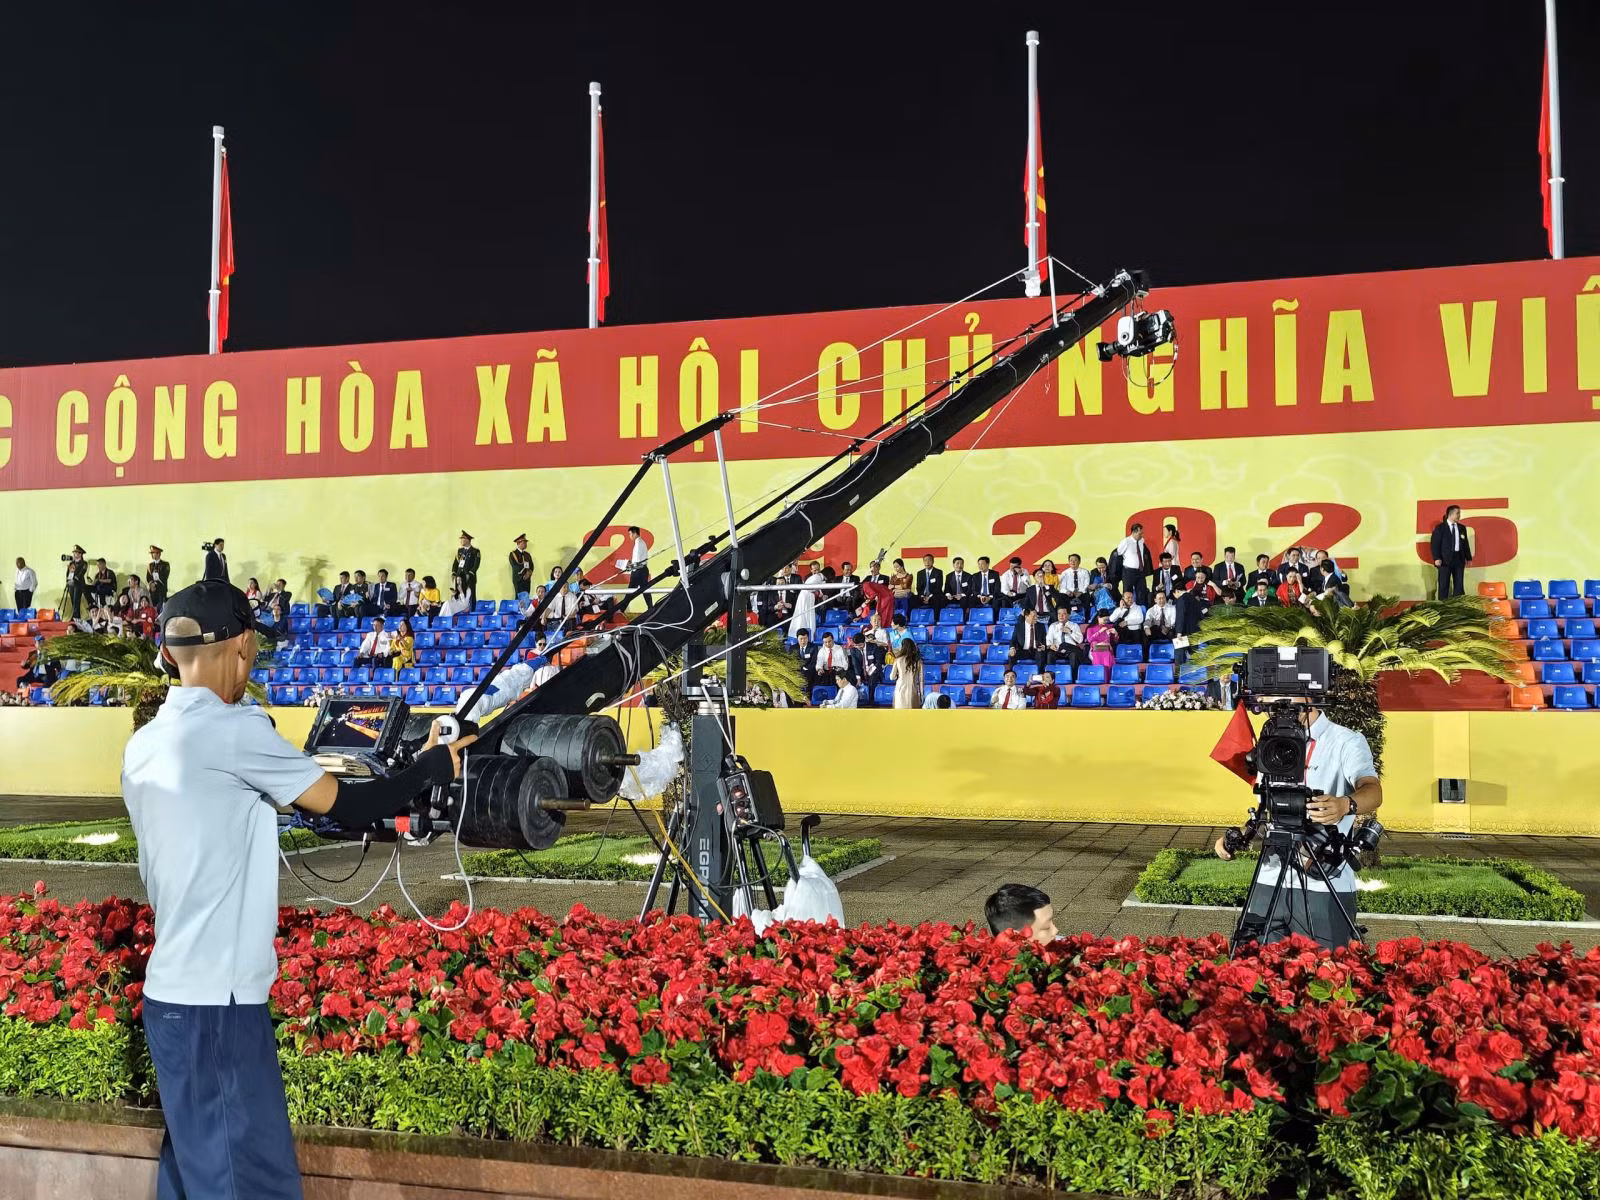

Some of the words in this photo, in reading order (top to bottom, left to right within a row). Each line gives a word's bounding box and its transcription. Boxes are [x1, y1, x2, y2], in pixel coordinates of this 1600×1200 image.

[56, 374, 237, 478] CỘNG
[286, 361, 428, 454] HÒA
[475, 348, 567, 445] XÃ
[619, 337, 759, 453] HỘI
[1058, 298, 1374, 416] NGHĨA
